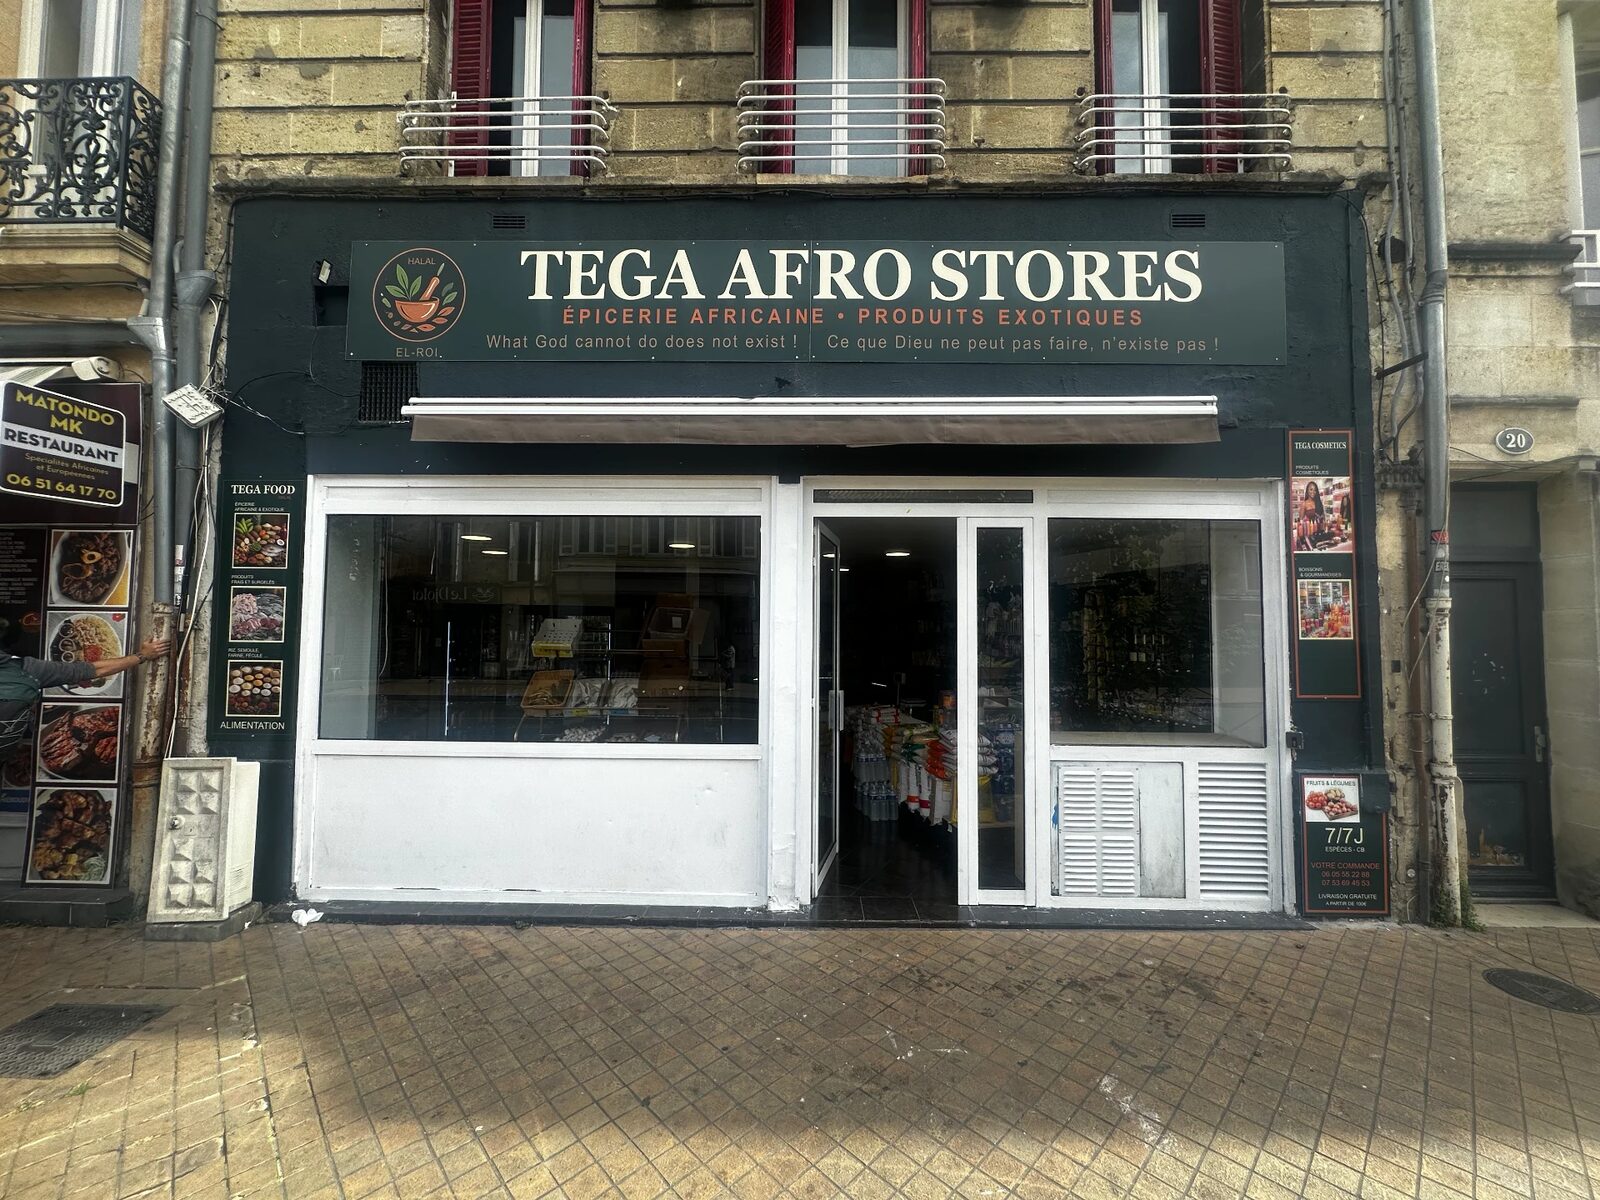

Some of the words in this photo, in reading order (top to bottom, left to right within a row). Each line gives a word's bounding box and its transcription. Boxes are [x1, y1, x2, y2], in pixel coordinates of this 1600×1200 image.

[407, 257, 436, 265] HALAL
[519, 247, 707, 301] TEGA
[716, 247, 913, 301] AFRO
[929, 248, 1203, 303] STORES
[562, 305, 678, 325] ÉPICERIE
[689, 308, 824, 325] AFRICAINE
[857, 308, 985, 325] PRODUITS
[998, 309, 1143, 326] EXOTIQUES
[486, 334, 528, 349] What
[535, 334, 568, 349] God
[575, 335, 631, 349] cannot
[638, 334, 658, 349] do
[665, 334, 705, 349] does
[712, 335, 739, 349] not
[745, 334, 786, 349] exist
[827, 334, 850, 350] Ce
[857, 337, 887, 351] que
[895, 335, 933, 350] Dieu
[940, 338, 961, 350] ne
[967, 338, 1005, 352] peut
[1012, 338, 1042, 353] pas
[1049, 336, 1094, 352] faire,
[1102, 336, 1170, 351] n'existe
[1177, 339, 1207, 354] pas
[16, 389, 115, 426] MATONDO
[50, 414, 84, 435] MK
[4, 427, 119, 463] RESTAURANT
[1295, 441, 1312, 450] TEGA
[1311, 441, 1347, 450] COSMETICS
[1506, 433, 1526, 448] 20
[6, 473, 32, 487] 06
[35, 477, 52, 491] 51
[55, 481, 76, 494] 64
[79, 485, 94, 497] 17
[96, 487, 117, 500] 70
[230, 484, 262, 495] TEGA
[263, 484, 296, 495] FOOD
[219, 720, 285, 730] ALIMENTATION
[1324, 827, 1364, 845] 7/7J
[1337, 862, 1381, 870] COMMANDE
[1348, 893, 1377, 901] GRATUITE
